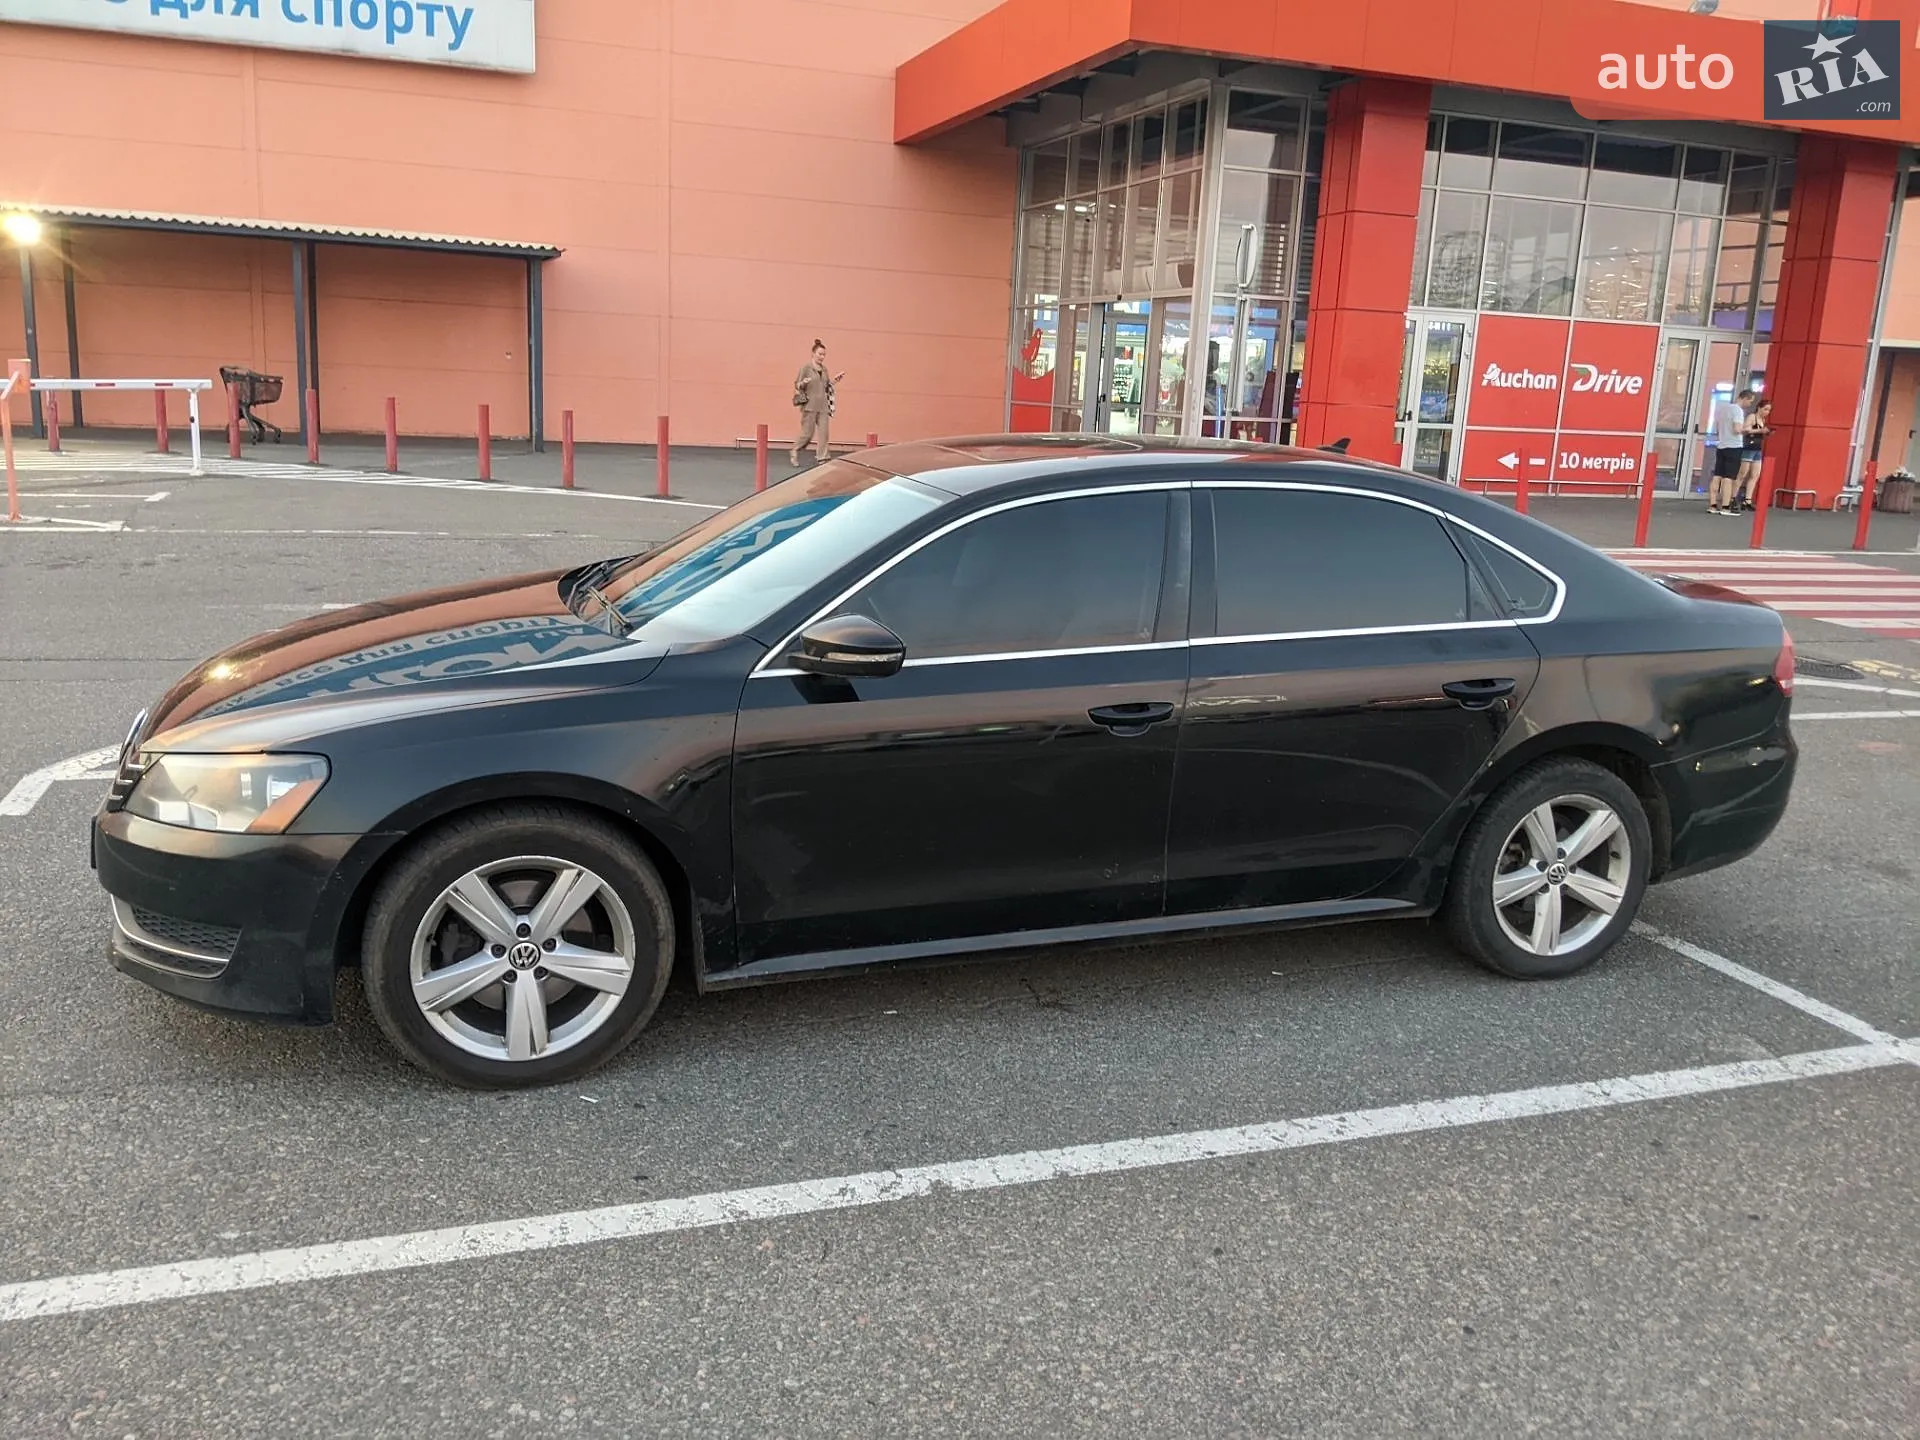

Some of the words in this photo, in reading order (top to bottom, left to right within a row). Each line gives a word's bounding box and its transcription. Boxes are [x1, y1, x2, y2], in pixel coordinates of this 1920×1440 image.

[281, 0, 474, 51] спорту
[1481, 363, 1557, 390] Auchan
[1570, 363, 1643, 395] Drive
[1559, 452, 1580, 469] 10
[1582, 453, 1635, 474] метрів
